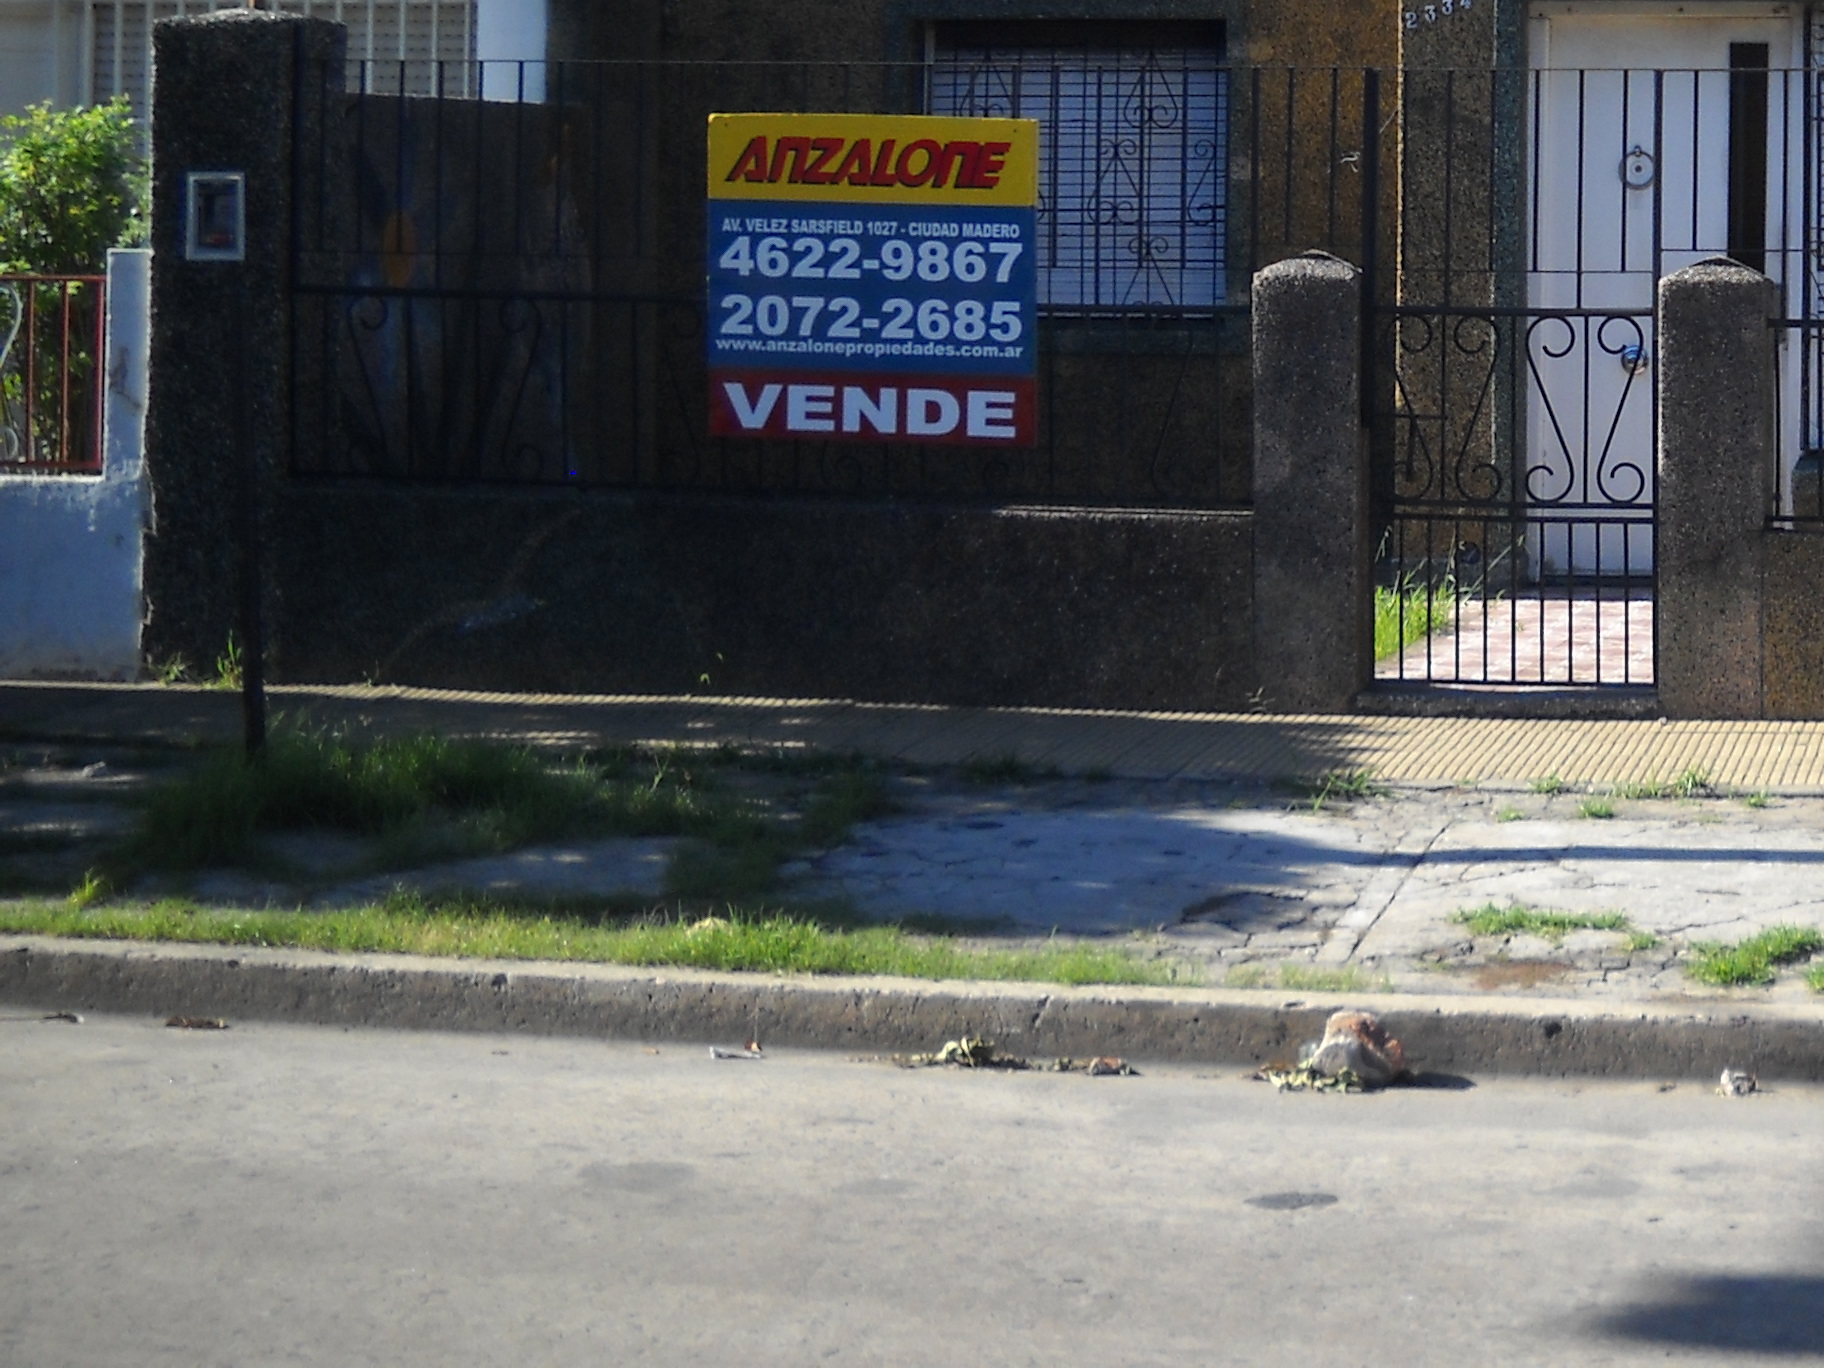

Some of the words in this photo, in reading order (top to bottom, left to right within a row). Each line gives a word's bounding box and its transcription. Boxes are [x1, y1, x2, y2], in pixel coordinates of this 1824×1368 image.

[724, 136, 1012, 189] ANZALONE
[722, 218, 742, 232] AV.
[745, 218, 788, 233] VELEZ
[791, 219, 863, 234] SARSFIELD
[867, 221, 898, 236] 1027
[908, 222, 960, 237] CIUDAD
[962, 223, 1020, 238] MADERO
[719, 236, 1023, 282] 4622-9867
[720, 294, 1023, 342] 2072-2685
[715, 338, 1024, 358] www.anzalonepropiedades.com.ar
[723, 382, 1016, 438] VENDE
